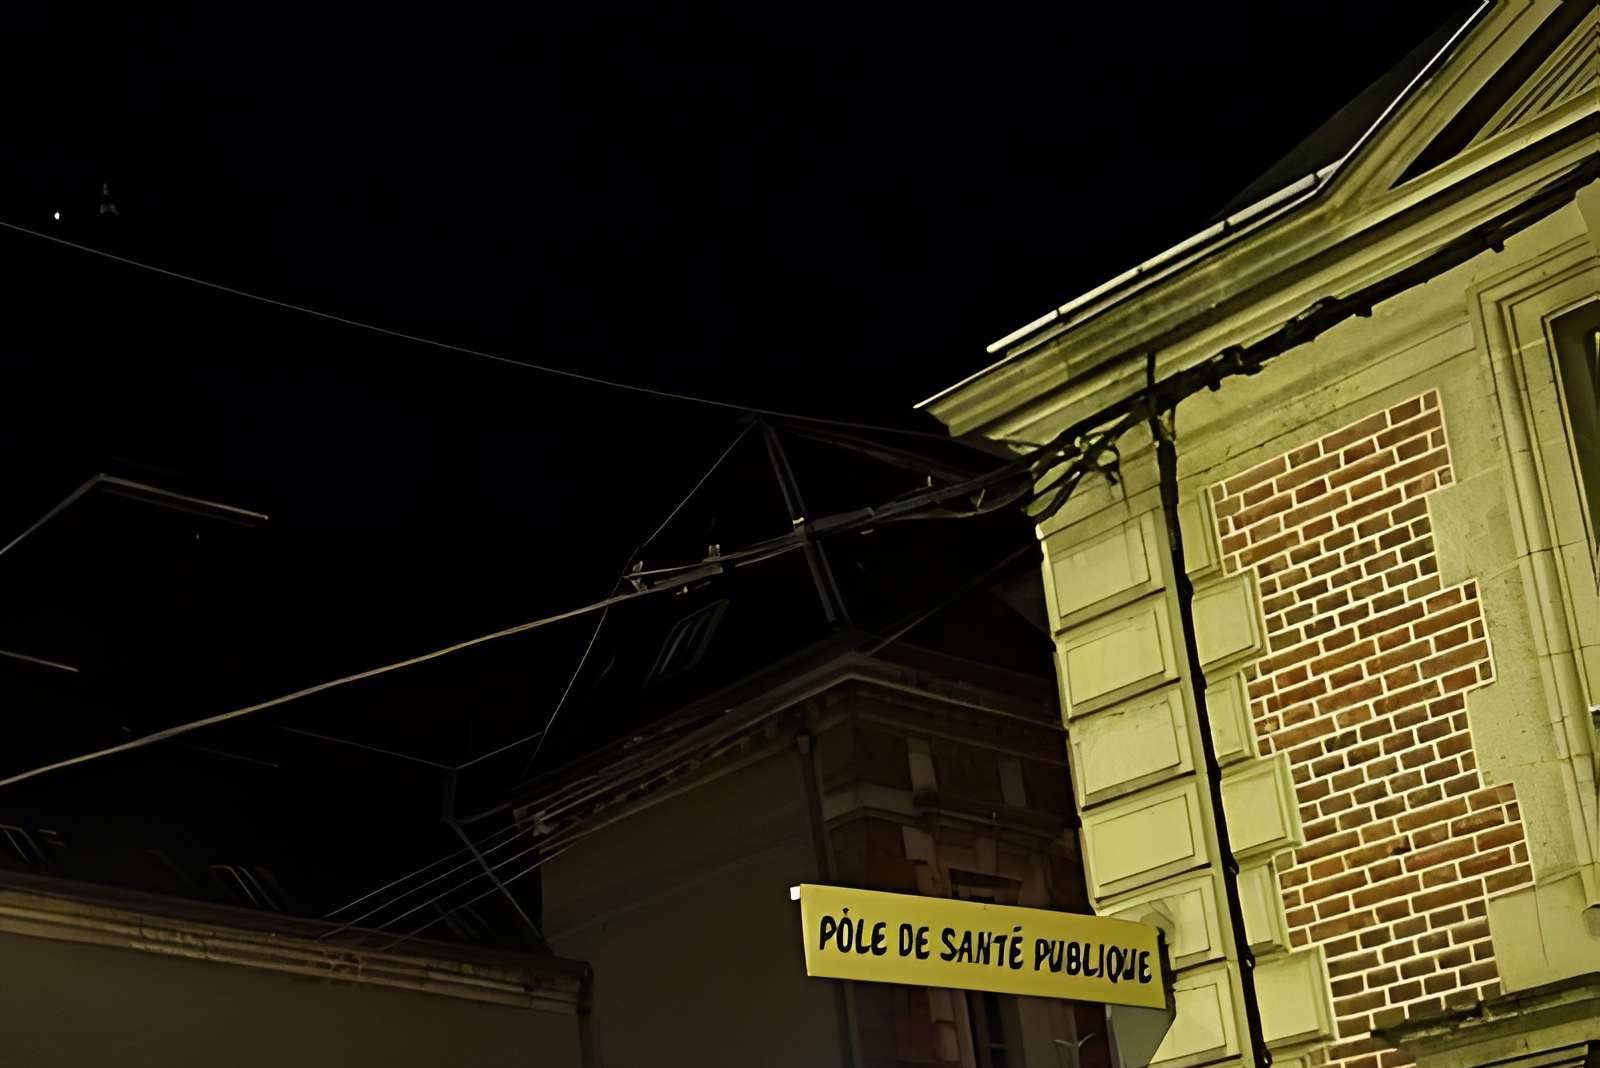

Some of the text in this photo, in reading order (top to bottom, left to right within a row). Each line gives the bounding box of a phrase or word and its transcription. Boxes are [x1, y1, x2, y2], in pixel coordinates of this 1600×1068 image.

[819, 907, 1153, 985] PÔLE DE SANTÉ PUBLIQUE
